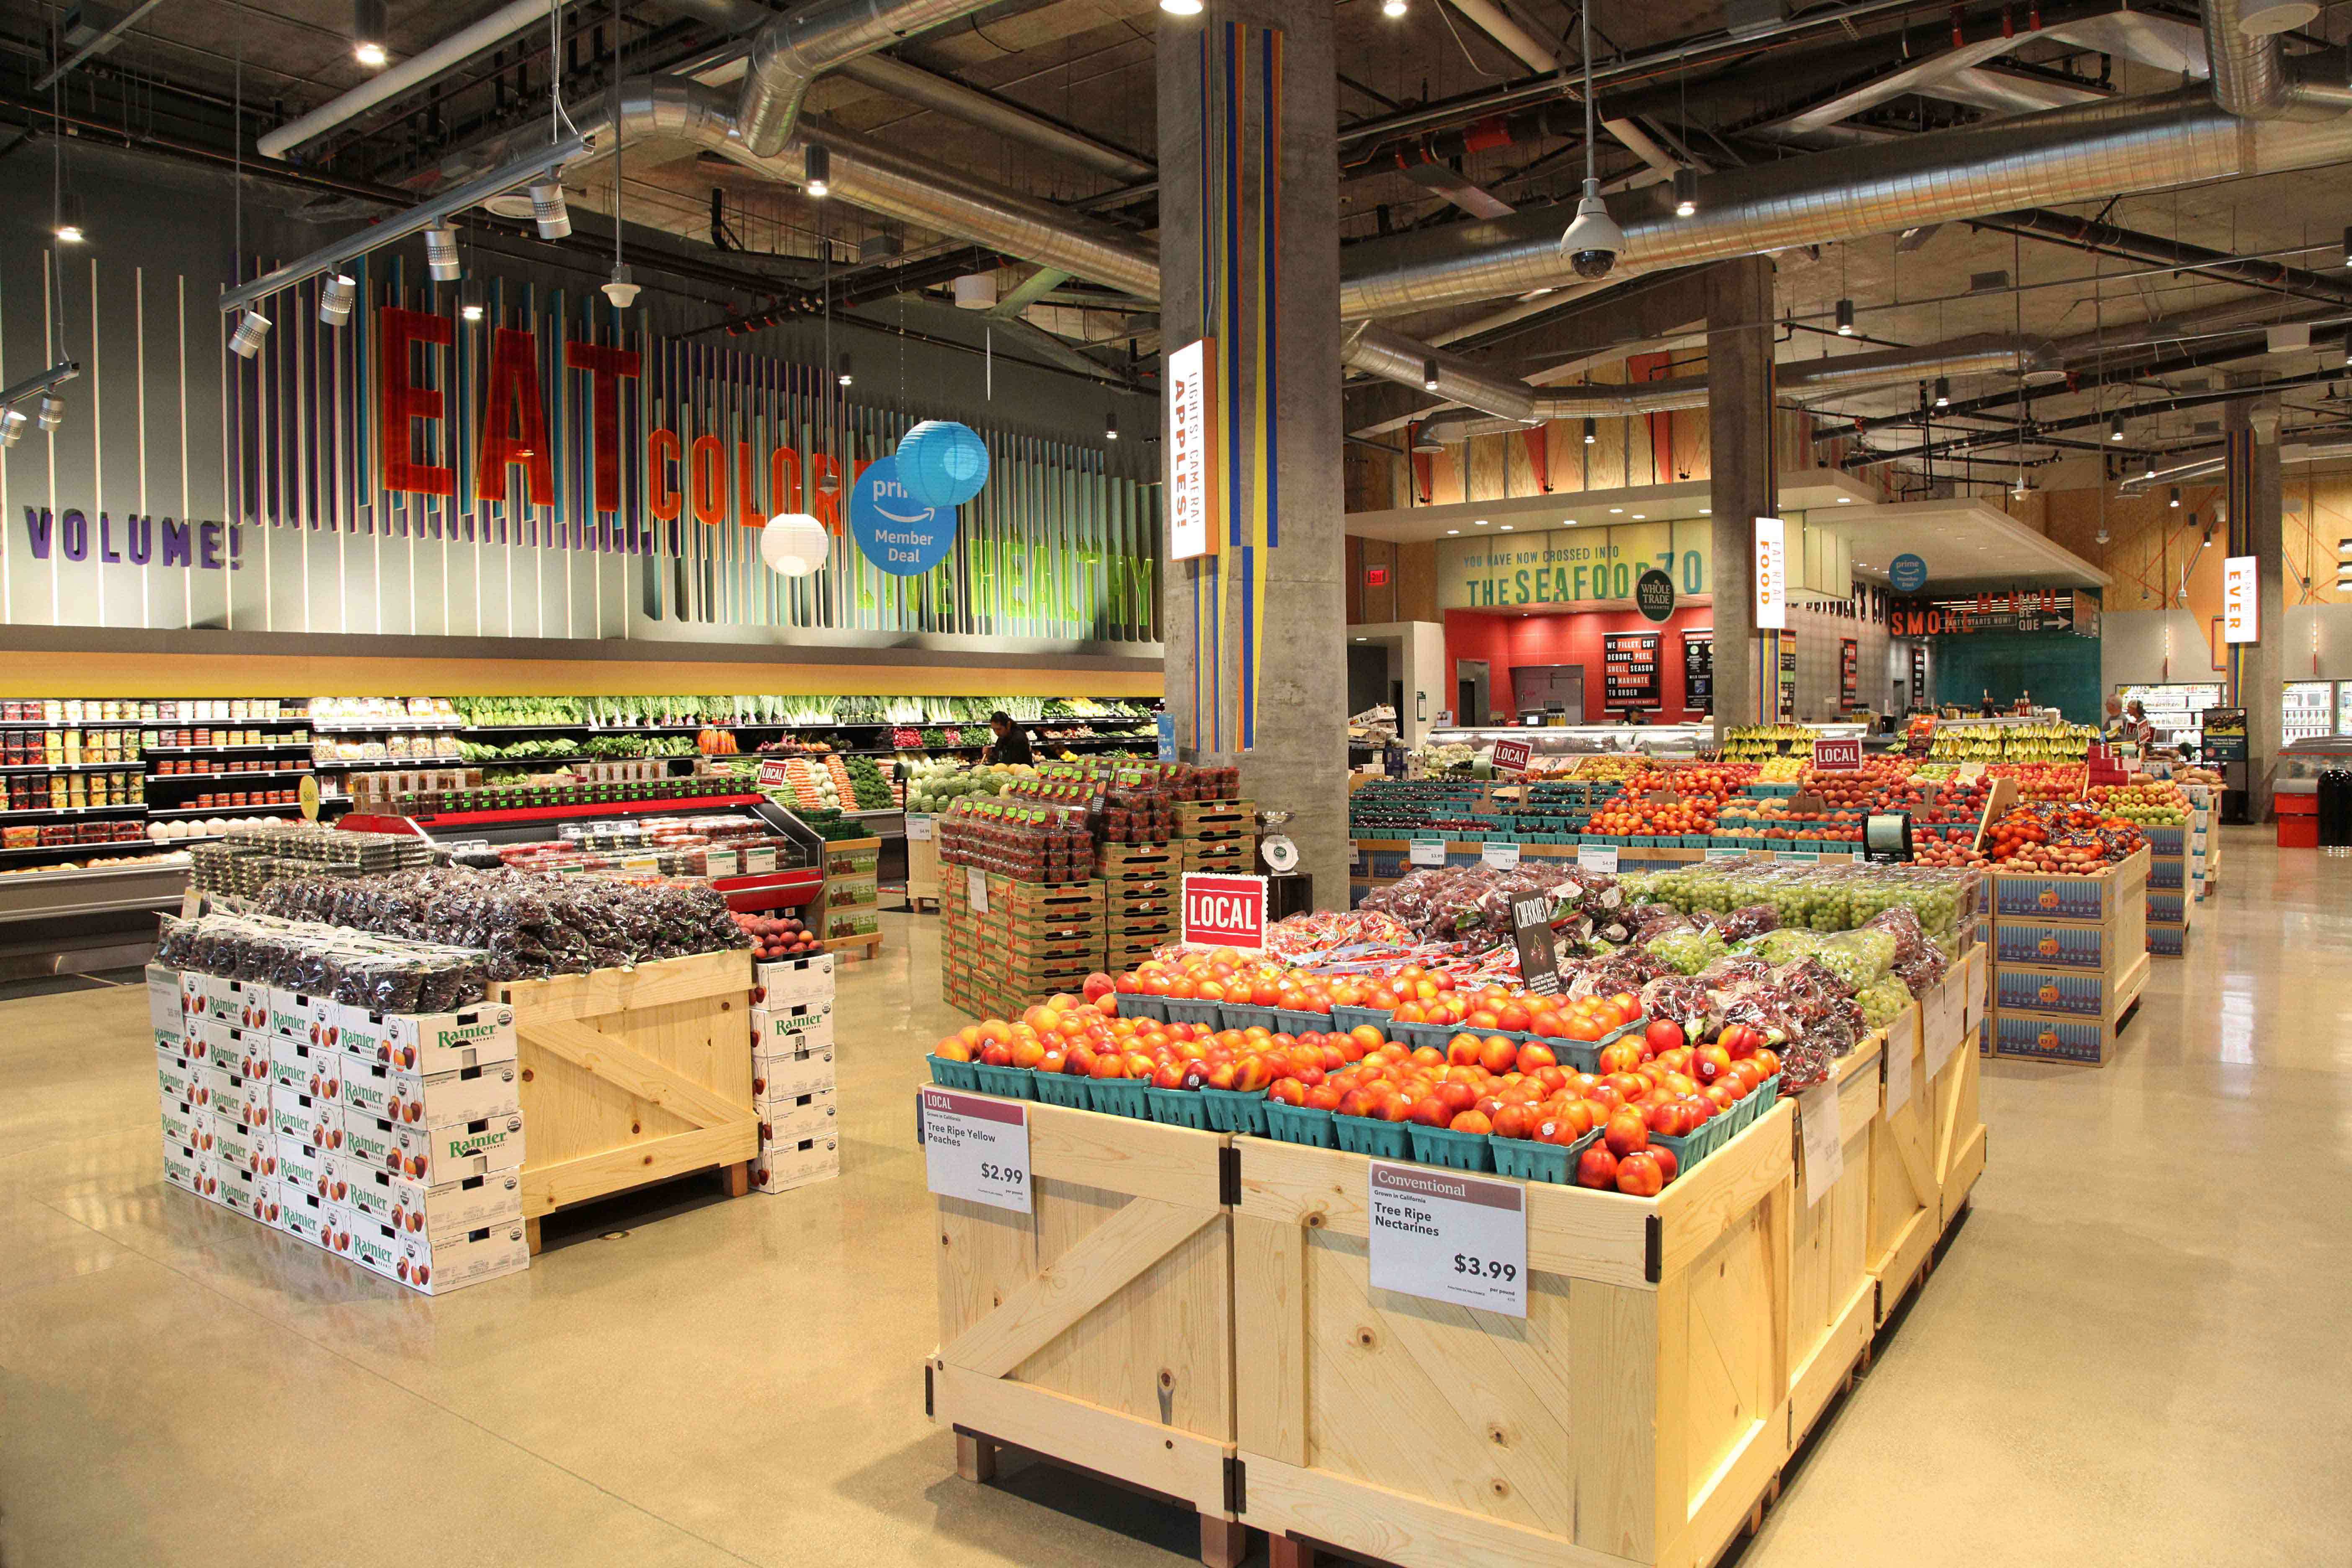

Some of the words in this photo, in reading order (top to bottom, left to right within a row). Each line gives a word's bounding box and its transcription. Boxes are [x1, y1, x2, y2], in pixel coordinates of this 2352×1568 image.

[382, 307, 640, 512] EAT
[1189, 371, 1199, 441] LIGHTS!
[1176, 380, 1186, 528] APPLES!
[648, 429, 874, 536] COLOR
[873, 480, 908, 501] pri
[1190, 449, 1200, 524] CAMERA!
[26, 510, 241, 570] VOLUME!
[875, 529, 933, 545] Member
[888, 548, 920, 563] Deal
[1464, 556, 1482, 567] YOU
[1487, 554, 1511, 566] HAVE
[1516, 552, 1537, 564] NOW
[1543, 548, 1590, 562] CROSSED
[1595, 546, 1619, 559] INTO
[1772, 542, 1781, 562] EAT
[1761, 541, 1769, 604] FOOD
[1896, 560, 1919, 568] prime
[970, 539, 1153, 626] HEALTHY
[1467, 579, 1509, 606] THE
[1641, 583, 1671, 594] WHOLE
[1772, 572, 1781, 600] REAL
[1642, 594, 1669, 603] TRADE
[2018, 594, 2038, 605] BAR
[2229, 571, 2241, 628] EVER
[1892, 610, 1974, 635] SMOKE
[2018, 619, 2039, 631] QUE
[1496, 747, 1524, 764] LOCAL
[1818, 748, 1856, 762] LOCAL
[762, 768, 783, 780] LOCAL
[304, 791, 315, 801] Sale
[851, 884, 875, 895] BEST
[852, 915, 875, 924] BEST
[1190, 895, 1257, 930] LOCAL
[1515, 897, 1547, 929] CHERRIES
[209, 995, 238, 1014] Rainier
[272, 1010, 306, 1031] Rainier
[776, 1014, 823, 1036] Rainier
[341, 1027, 376, 1049] Rainier
[437, 1024, 496, 1048] Rainier
[210, 1044, 239, 1064] Rainier
[159, 1070, 184, 1089] Rainier
[272, 1060, 307, 1081] Rainier
[211, 1089, 239, 1109] Rainier
[344, 1079, 384, 1104] Rainier
[928, 1094, 952, 1109] LOCAL
[162, 1112, 188, 1133] Rainier
[275, 1108, 309, 1131] Rainier
[927, 1122, 945, 1132] Tree
[947, 1125, 965, 1138] Ripe
[967, 1129, 995, 1142] Yellow
[928, 1133, 961, 1146] Peaches
[217, 1135, 246, 1158] Rainier
[347, 1131, 387, 1156] Rainier
[449, 1132, 507, 1158] Rainier
[483, 1142, 506, 1151] ORGANIC
[164, 1156, 191, 1177] Rainier
[280, 1157, 314, 1181] Rainier
[981, 1162, 1023, 1184] $2.99
[220, 1181, 250, 1203] Rainier
[1378, 1170, 1466, 1197] Conventional
[350, 1183, 387, 1212] Rainier
[1399, 1194, 1426, 1203] California
[283, 1204, 317, 1230] Rainier
[1374, 1202, 1401, 1216] Tree
[1404, 1207, 1432, 1222] Ripe
[1375, 1215, 1439, 1236] Nectarines
[354, 1233, 393, 1264] Rainier
[1454, 1253, 1516, 1282] $3.99
